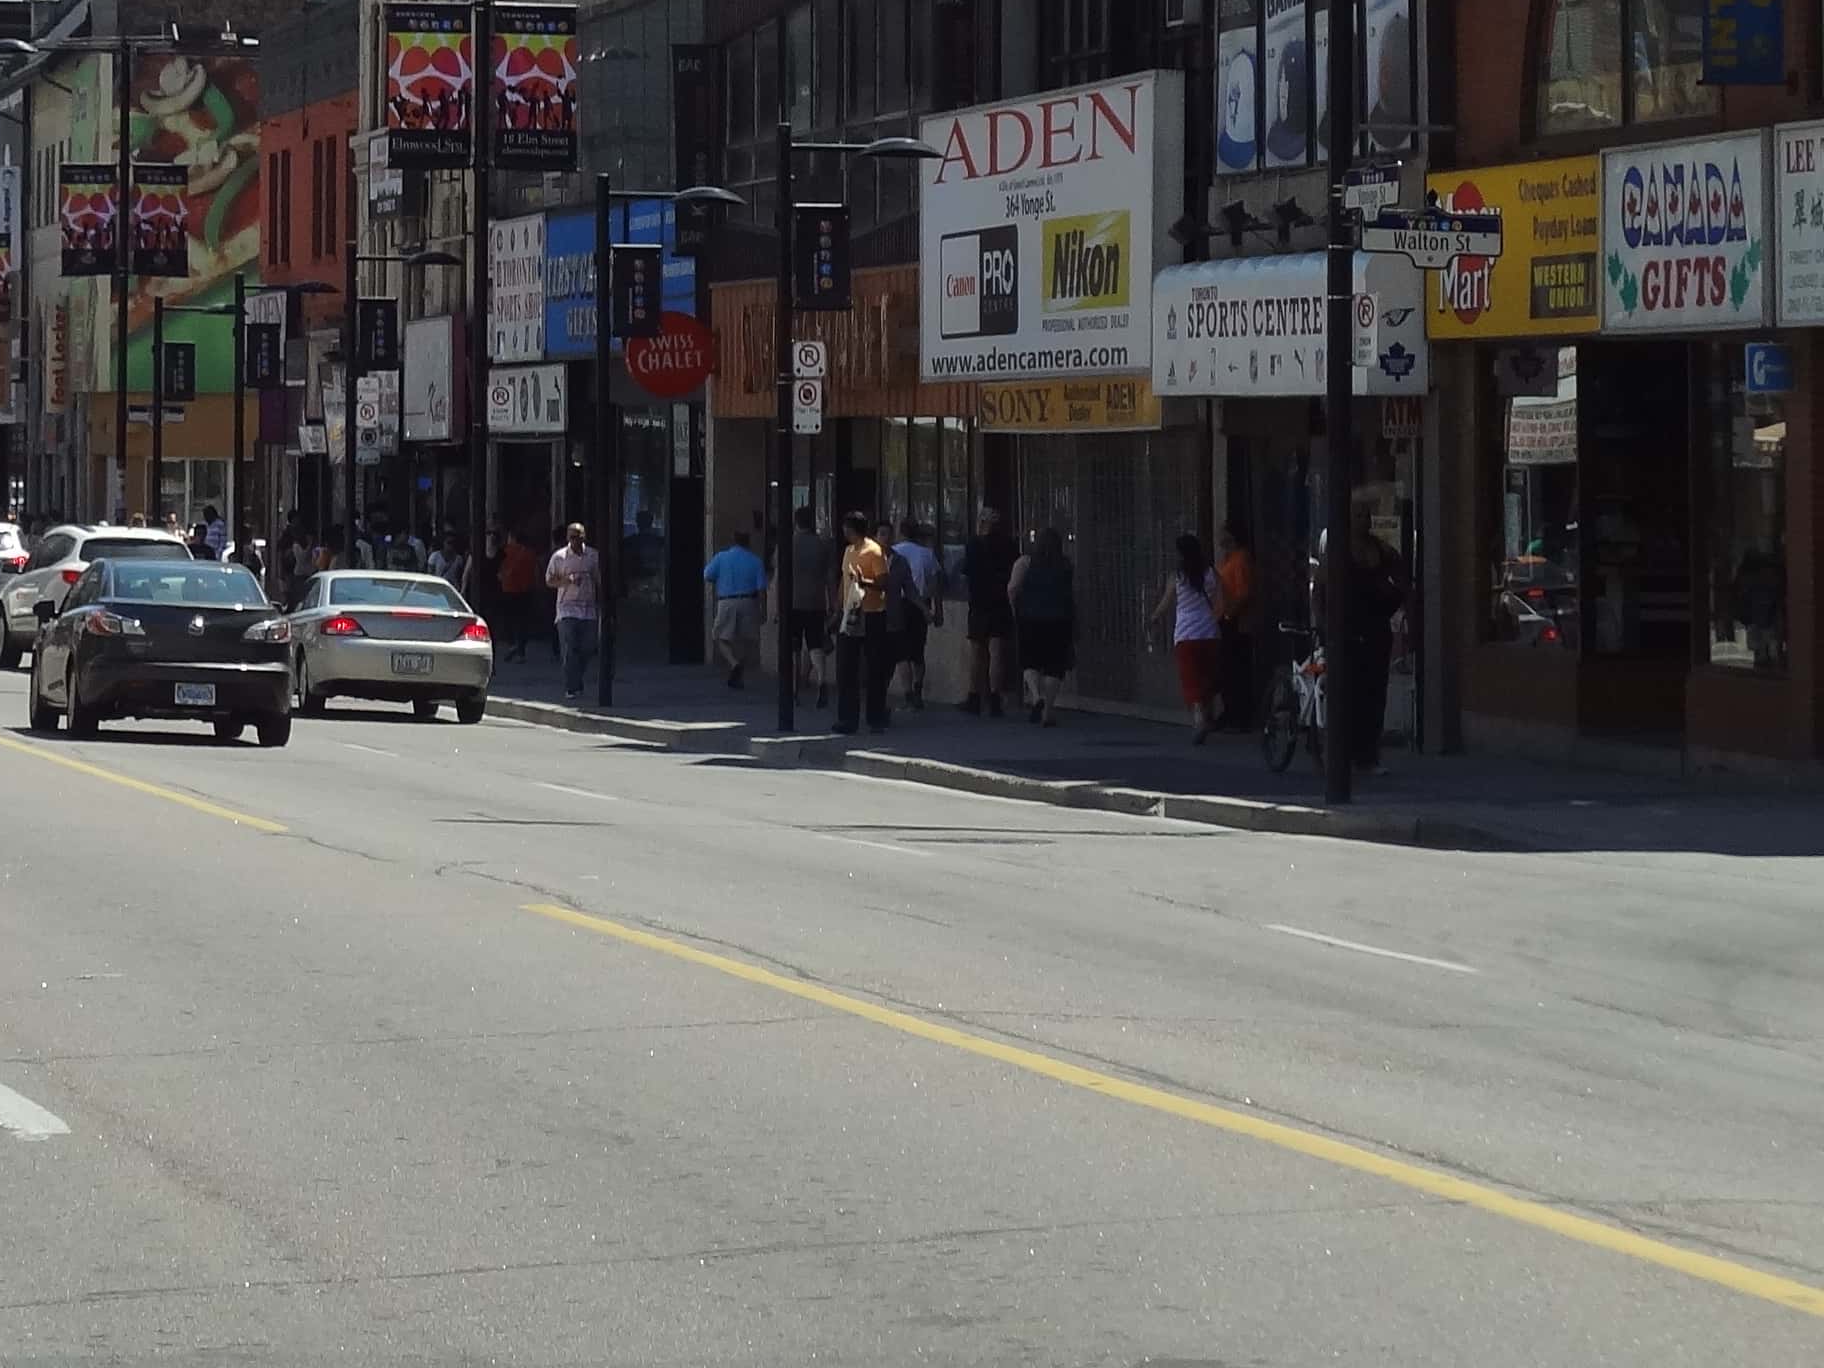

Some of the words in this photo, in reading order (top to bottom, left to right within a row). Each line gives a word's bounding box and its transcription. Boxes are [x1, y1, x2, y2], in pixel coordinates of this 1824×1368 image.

[391, 136, 441, 151] Elmwood
[541, 135, 569, 146] Street
[933, 84, 1143, 184] ADEN
[1785, 139, 1816, 174] LEE
[1518, 177, 1559, 206] Cheques
[1562, 170, 1596, 199] Cashed
[1621, 155, 1748, 250] CANADA
[1005, 192, 1020, 218] 364
[1020, 192, 1045, 220] Yonge
[1393, 231, 1450, 251] Walton
[1455, 234, 1471, 252] St
[1533, 214, 1568, 245] Payday
[982, 248, 1015, 296] PRO
[1051, 229, 1120, 300] Nikon
[1533, 262, 1586, 287] WESTERN
[946, 273, 976, 299] Canon
[1438, 255, 1491, 314] Mart
[1548, 285, 1585, 309] UNION
[1641, 254, 1726, 312] GIFTS
[1187, 299, 1248, 339] SPORTS
[1252, 295, 1323, 337] CENTRE
[648, 334, 695, 351] SWISS
[637, 349, 703, 374] CHALET
[931, 346, 1128, 374] www.adencamera.com
[980, 387, 1051, 424] SONY
[1383, 397, 1424, 425] ATM
